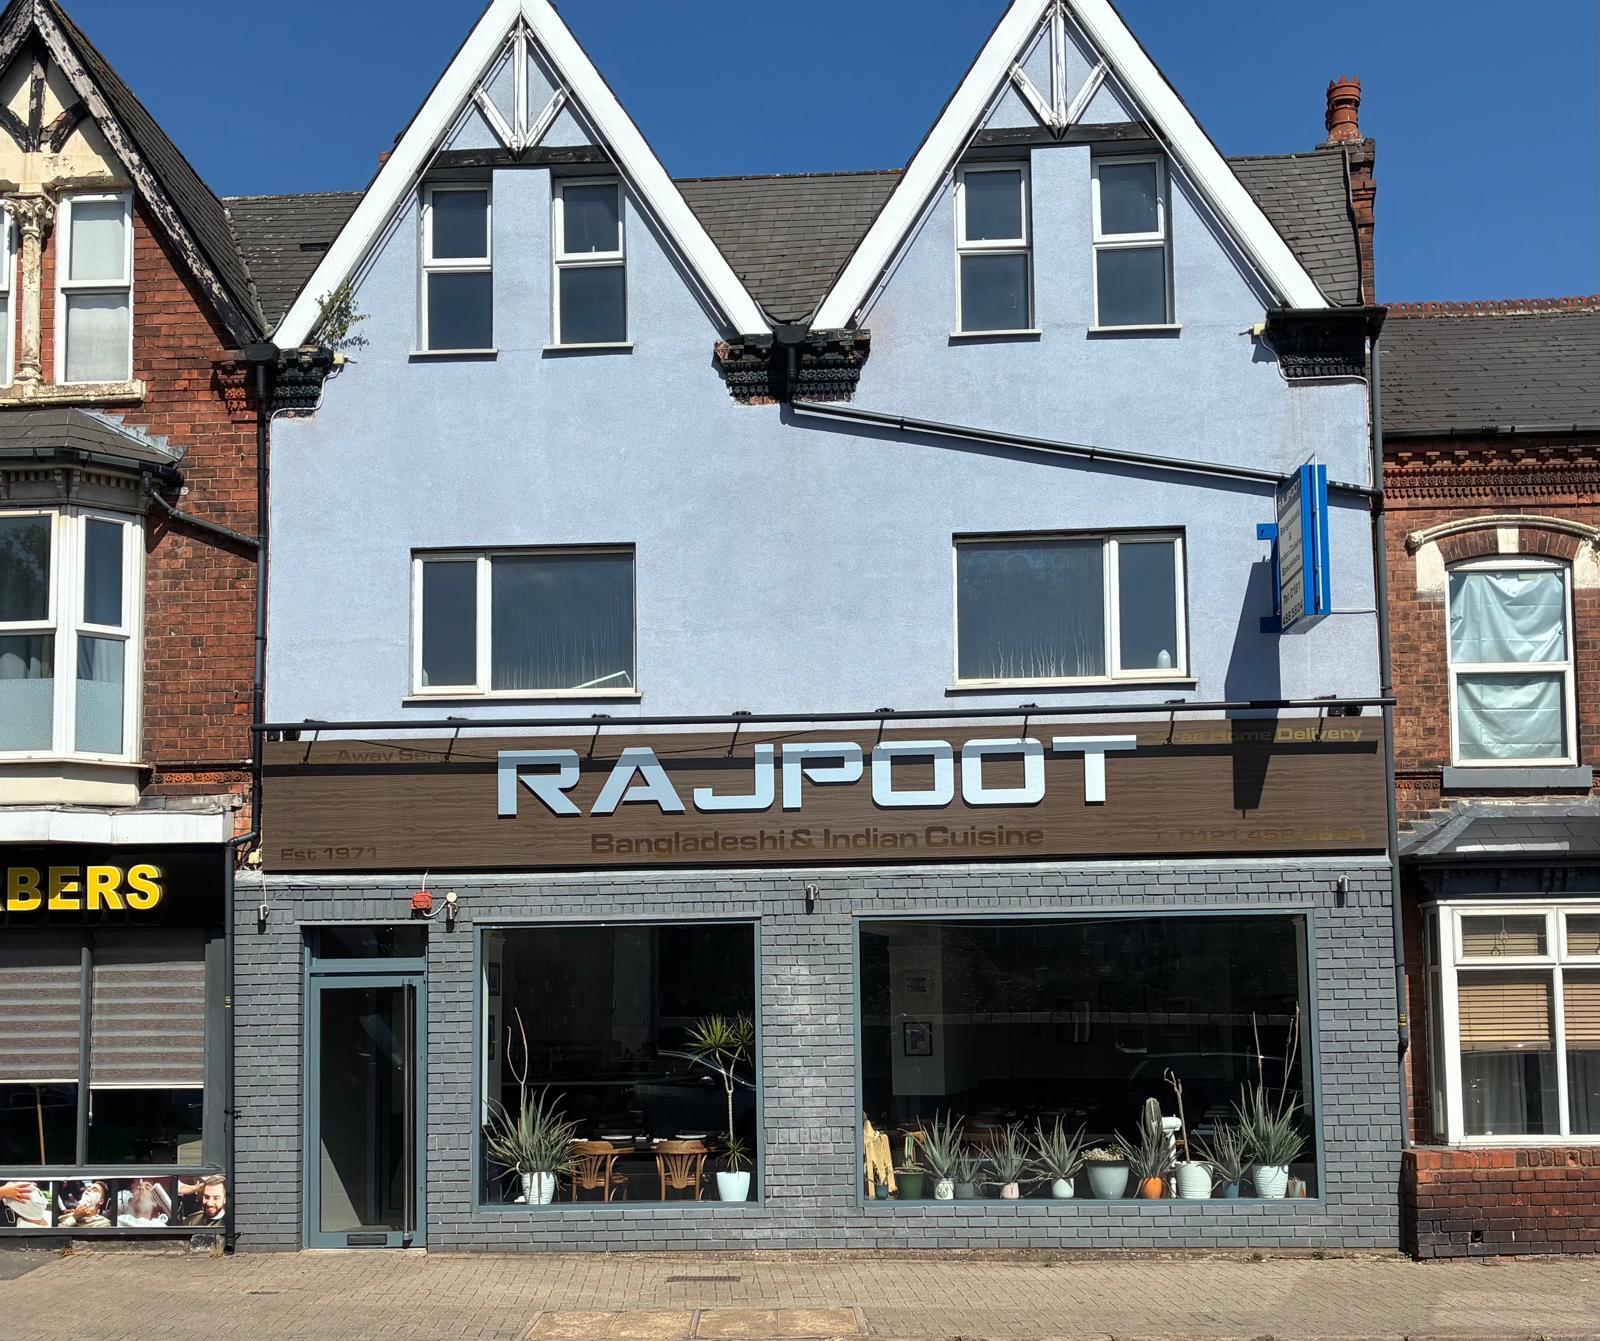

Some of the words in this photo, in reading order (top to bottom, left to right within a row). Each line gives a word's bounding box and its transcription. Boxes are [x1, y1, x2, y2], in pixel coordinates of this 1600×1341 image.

[497, 734, 1138, 817] RAJPOOT
[280, 848, 316, 861] Est
[322, 847, 377, 860] 1971
[591, 829, 785, 859] Bangladeshi
[790, 829, 815, 850] &
[823, 828, 918, 849] Indian
[925, 825, 1044, 847] Cuisine
[0, 864, 163, 911] BERS
